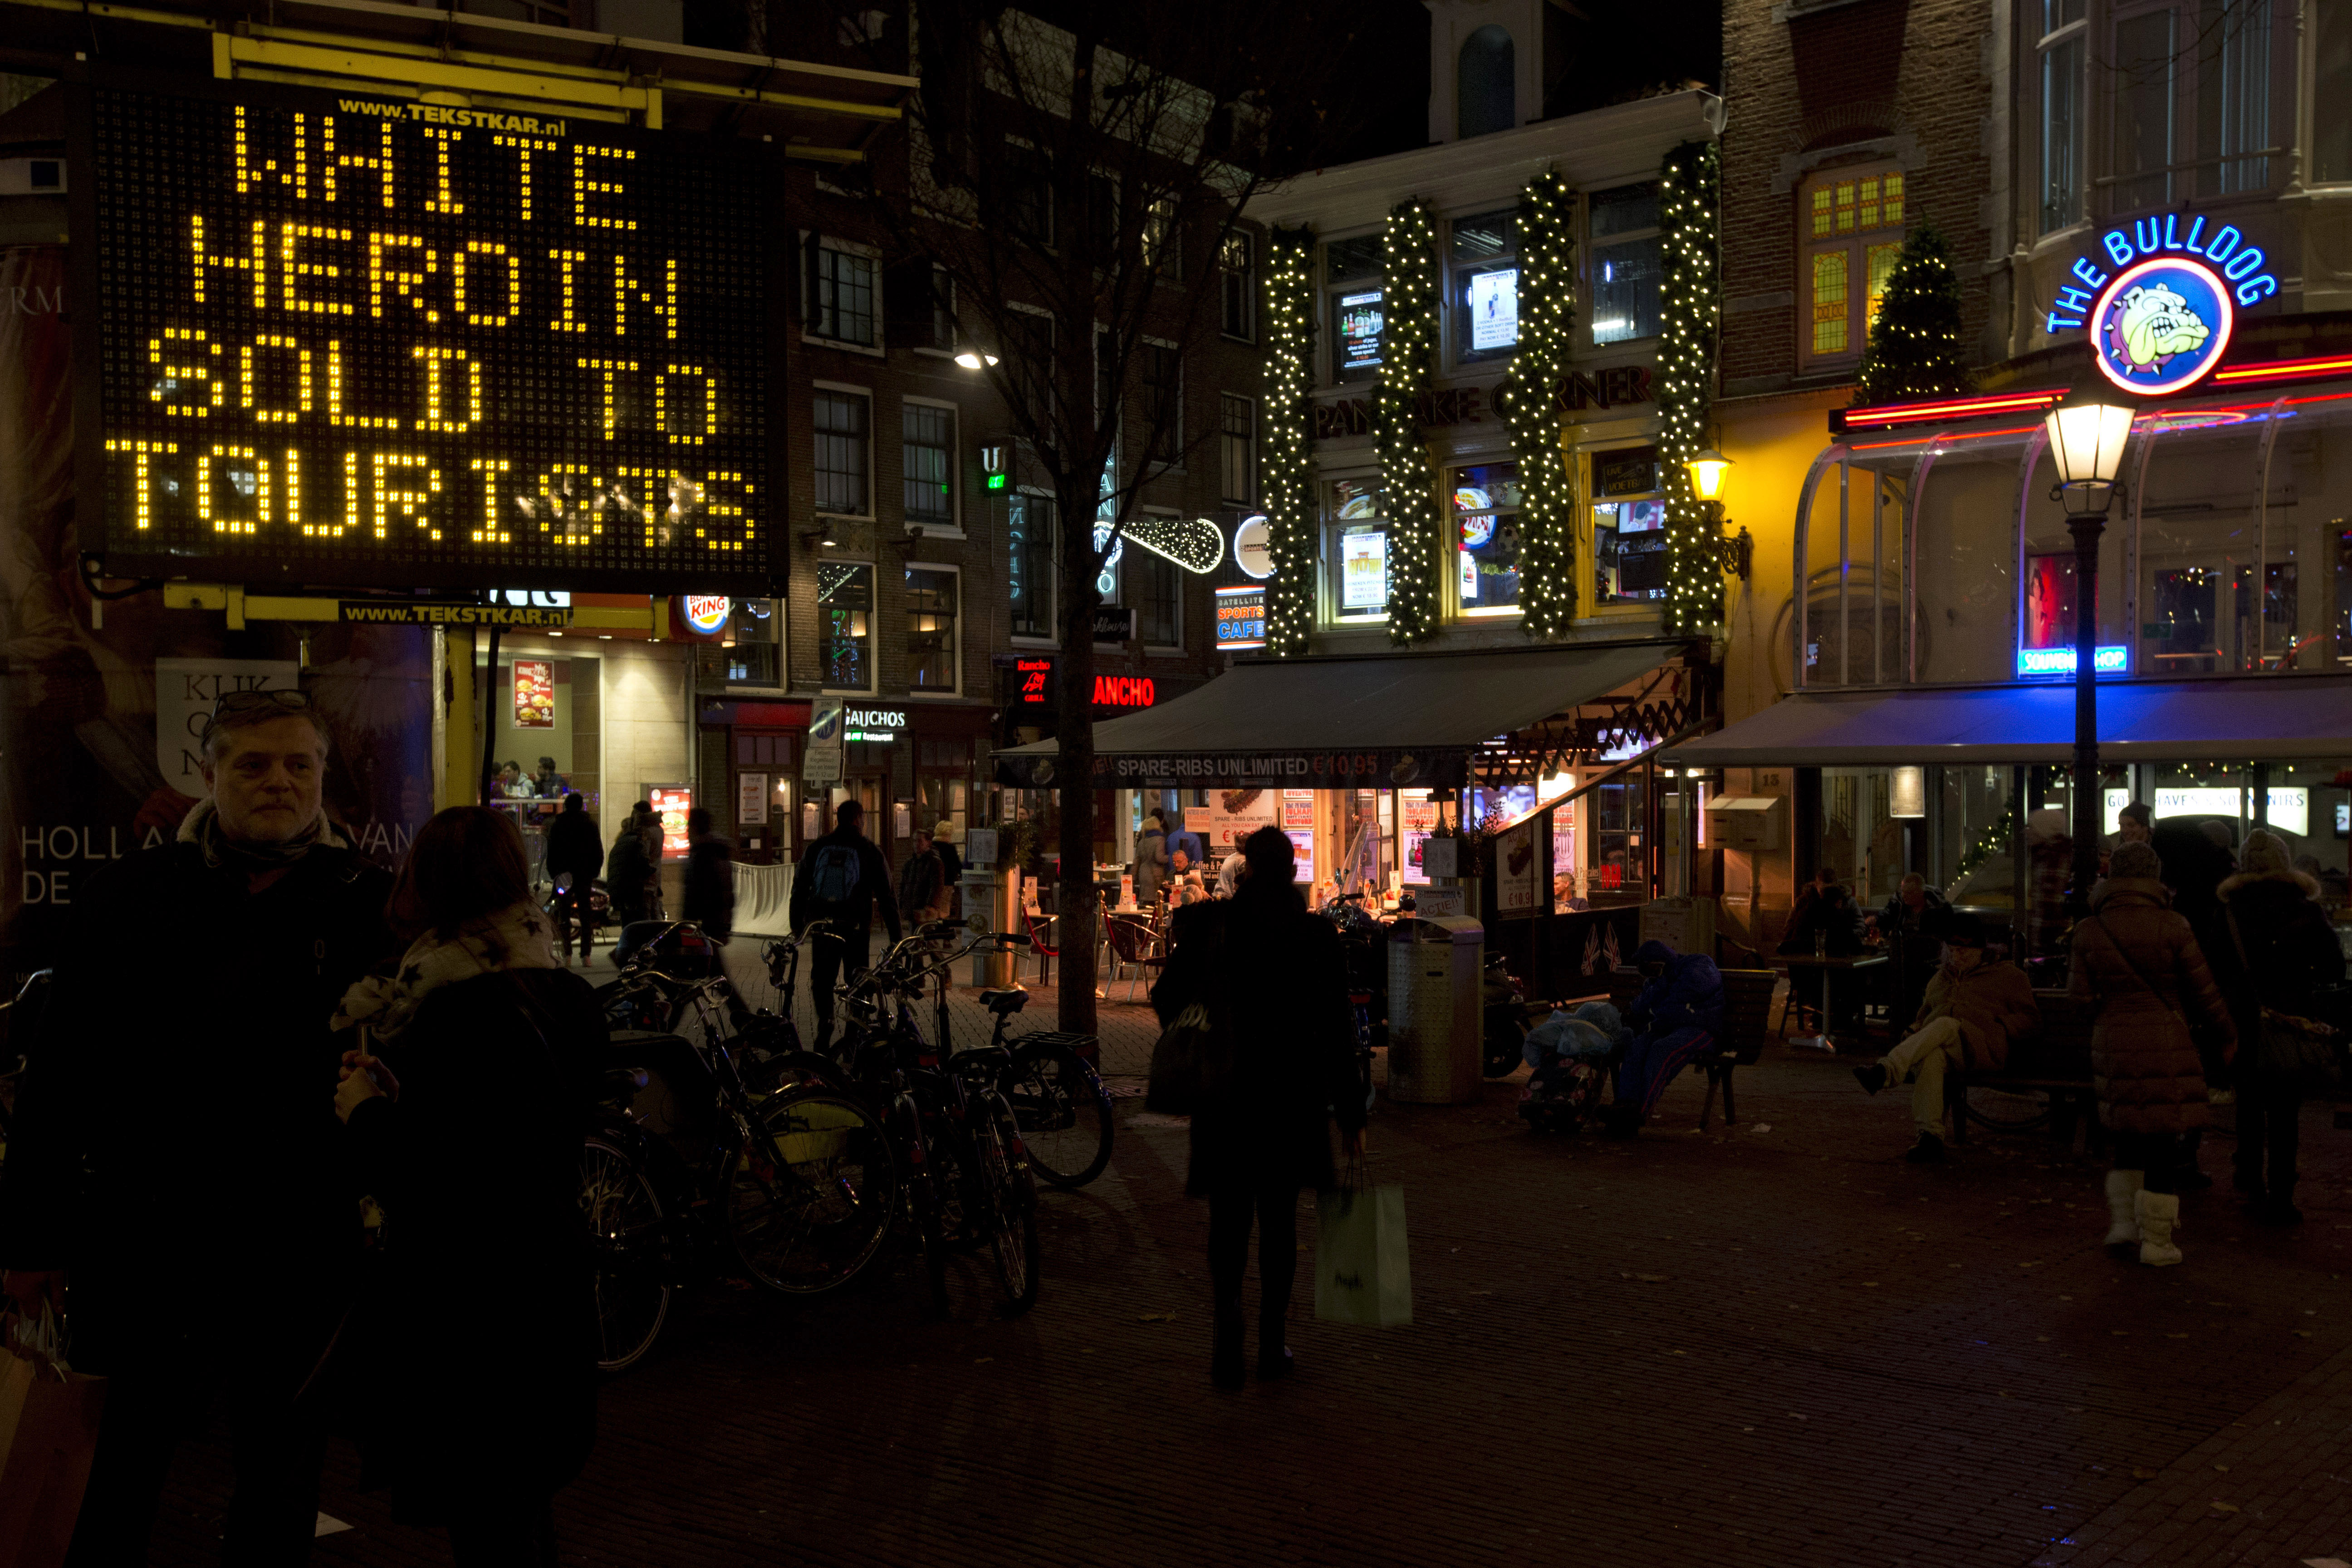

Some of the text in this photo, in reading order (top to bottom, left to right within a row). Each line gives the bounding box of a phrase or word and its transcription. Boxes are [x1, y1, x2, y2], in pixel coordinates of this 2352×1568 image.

[338, 98, 565, 137] www.TEKSTKAR.nl
[235, 105, 637, 230] WHITE
[2102, 212, 2278, 307] BULLDOG
[191, 215, 676, 339] HEROIN
[2047, 256, 2107, 333] THE
[149, 327, 716, 446] SOLD TO
[1316, 366, 1656, 439] PANAKE CRNER
[105, 438, 755, 550] TOURISTS
[691, 596, 725, 619] KING
[1218, 596, 1264, 606] SATELLITE
[1218, 605, 1265, 619] SPORTS
[345, 606, 568, 625] www.TEKSTKAR.nl
[1218, 620, 1265, 639] CAFE
[1017, 659, 1050, 671] Rancho
[2024, 651, 2125, 670] SOUVENI HOP
[1092, 676, 1154, 706] ANCHO
[1218, 757, 1308, 776] UNLIMITED
[347, 823, 412, 855] VAN
[1210, 862, 1215, 870] &
[22, 870, 72, 904] DE
[1509, 892, 1532, 906] €10,9
[1421, 898, 1459, 916] ACTIE!!
